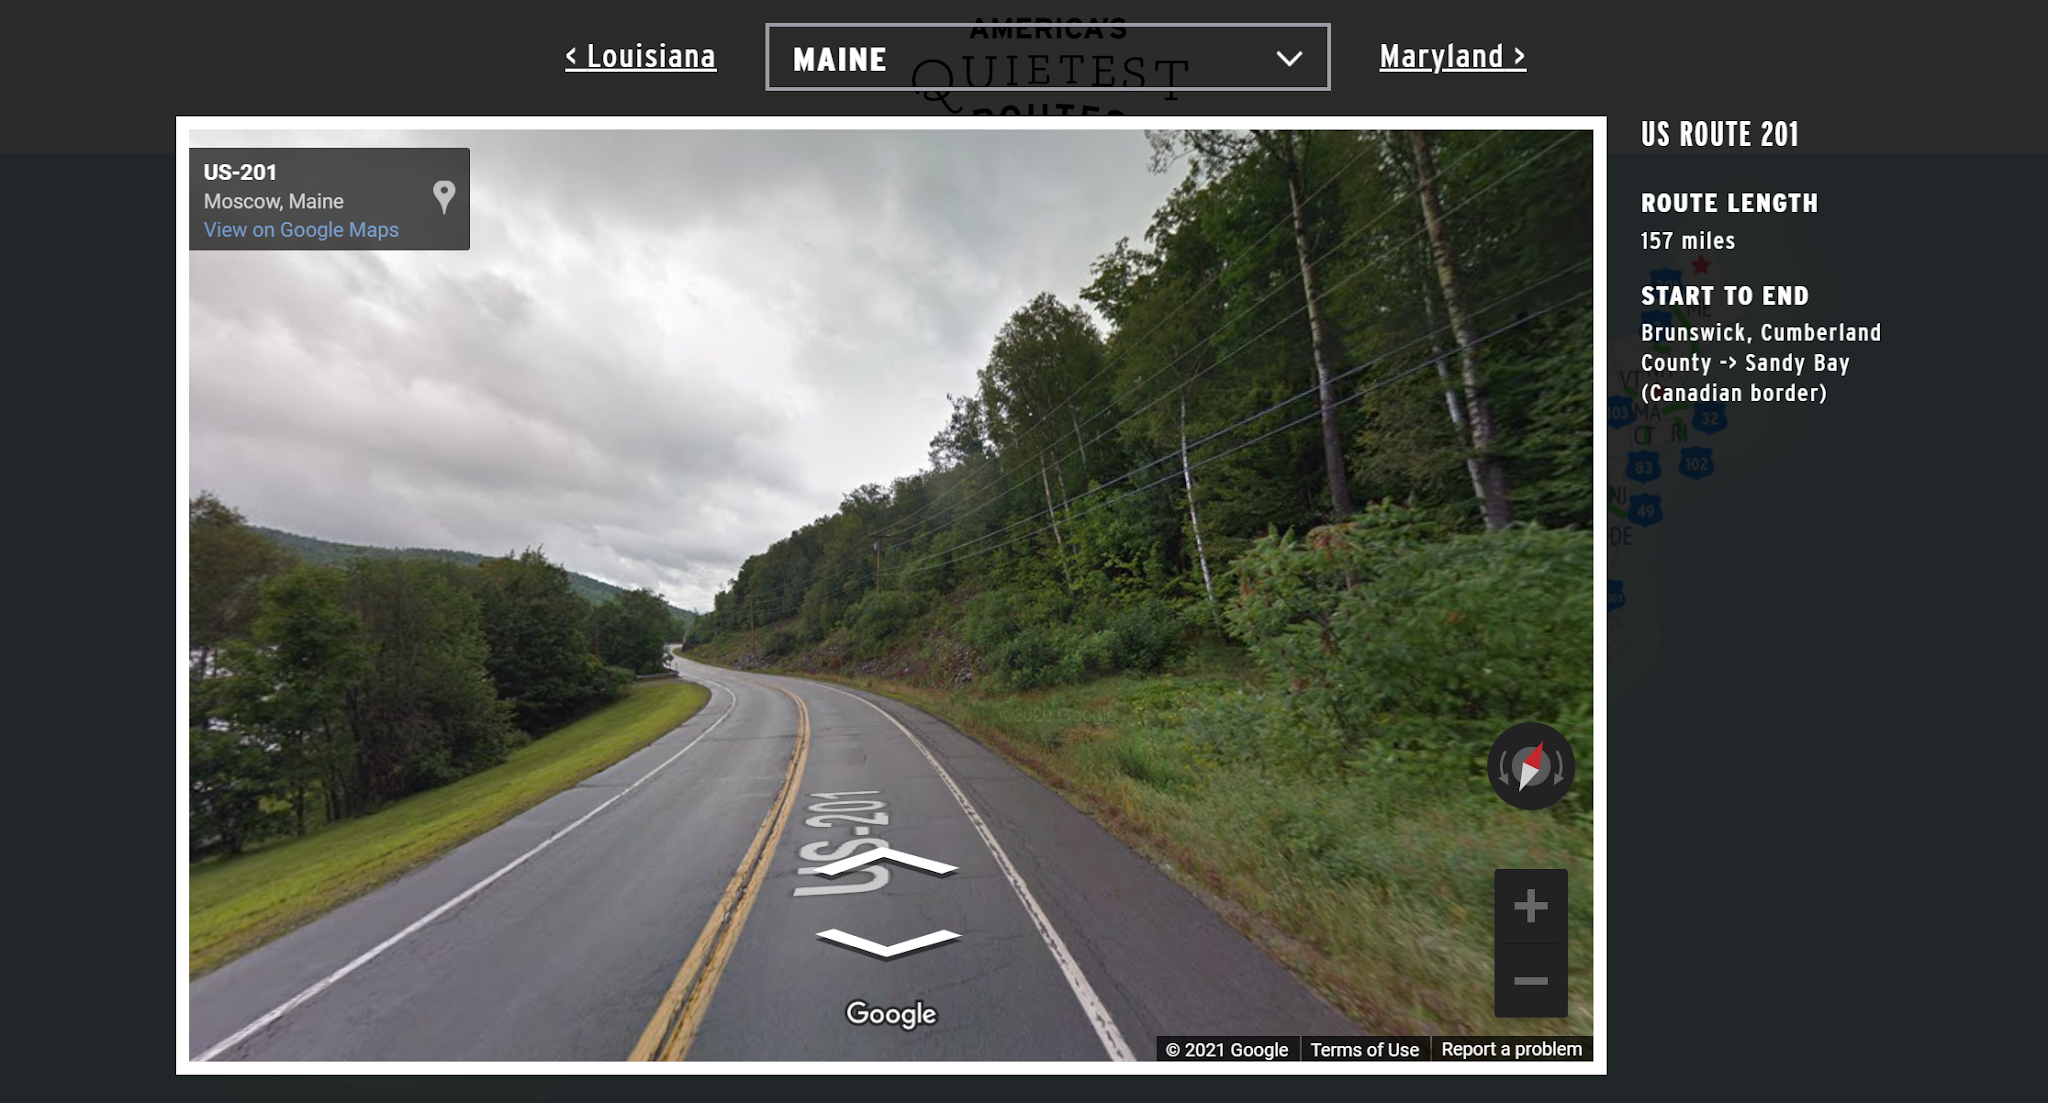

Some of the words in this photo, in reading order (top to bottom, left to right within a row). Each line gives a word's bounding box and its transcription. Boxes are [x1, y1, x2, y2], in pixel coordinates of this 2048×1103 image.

[969, 17, 1127, 40] AMERICA'S
[588, 43, 715, 68] Louisiana
[793, 47, 887, 72] MAINE
[1380, 43, 1503, 75] Maryland
[911, 54, 1189, 114] QUIETEST
[1641, 120, 1670, 147] US
[1680, 120, 1752, 147] ROUTE
[1760, 120, 1799, 147] 201
[1641, 192, 1718, 213] ROUTE
[1727, 192, 1818, 213] LENGTH
[1641, 231, 1674, 250] 157
[1681, 231, 1736, 250] miles
[1641, 285, 1715, 306] START
[1723, 285, 1753, 306] TO
[1762, 285, 1810, 306] END
[1641, 322, 1753, 344] Brunswick,
[1760, 322, 1882, 341] Cumberland
[1641, 353, 1712, 377] County
[1745, 353, 1806, 377] Sandy
[1814, 353, 1851, 377] Bay
[1641, 382, 1742, 404] (Canadian
[1750, 382, 1828, 404] border)
[1634, 403, 1661, 421] MA
[1702, 412, 1719, 425] 32
[1671, 423, 1688, 442] RI
[1635, 461, 1653, 474] 83
[1686, 458, 1708, 470] 102
[1638, 504, 1655, 517] 49
[1610, 526, 1633, 545] DE
